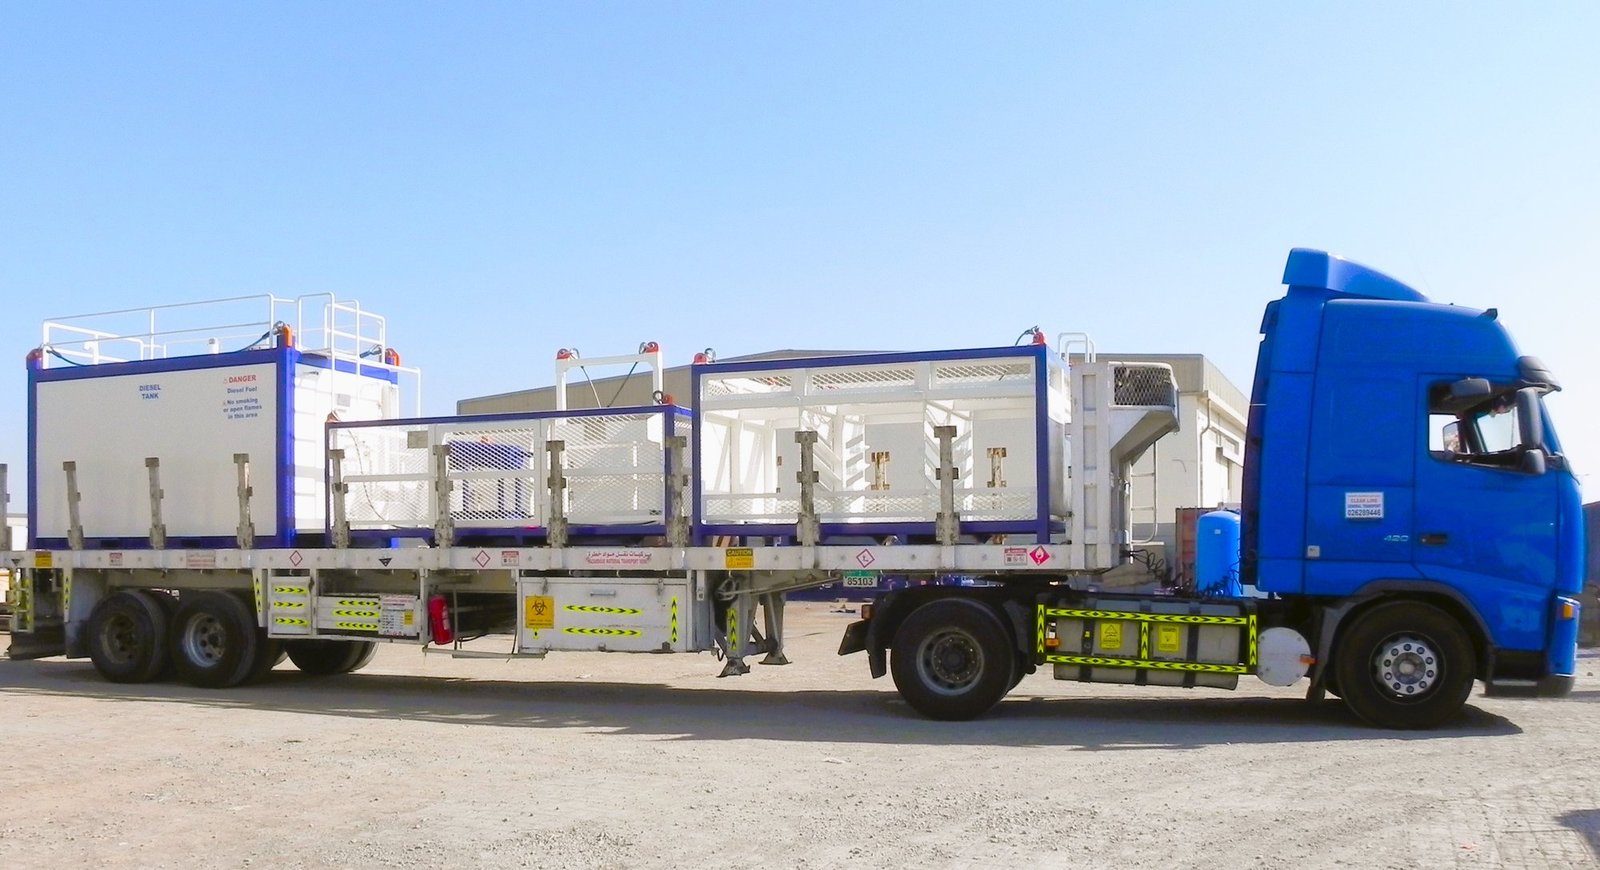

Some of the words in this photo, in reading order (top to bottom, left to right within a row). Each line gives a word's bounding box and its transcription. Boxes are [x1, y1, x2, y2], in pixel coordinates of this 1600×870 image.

[228, 374, 257, 383] DANGER
[1383, 534, 1409, 542] 420
[847, 577, 873, 586] 85103
